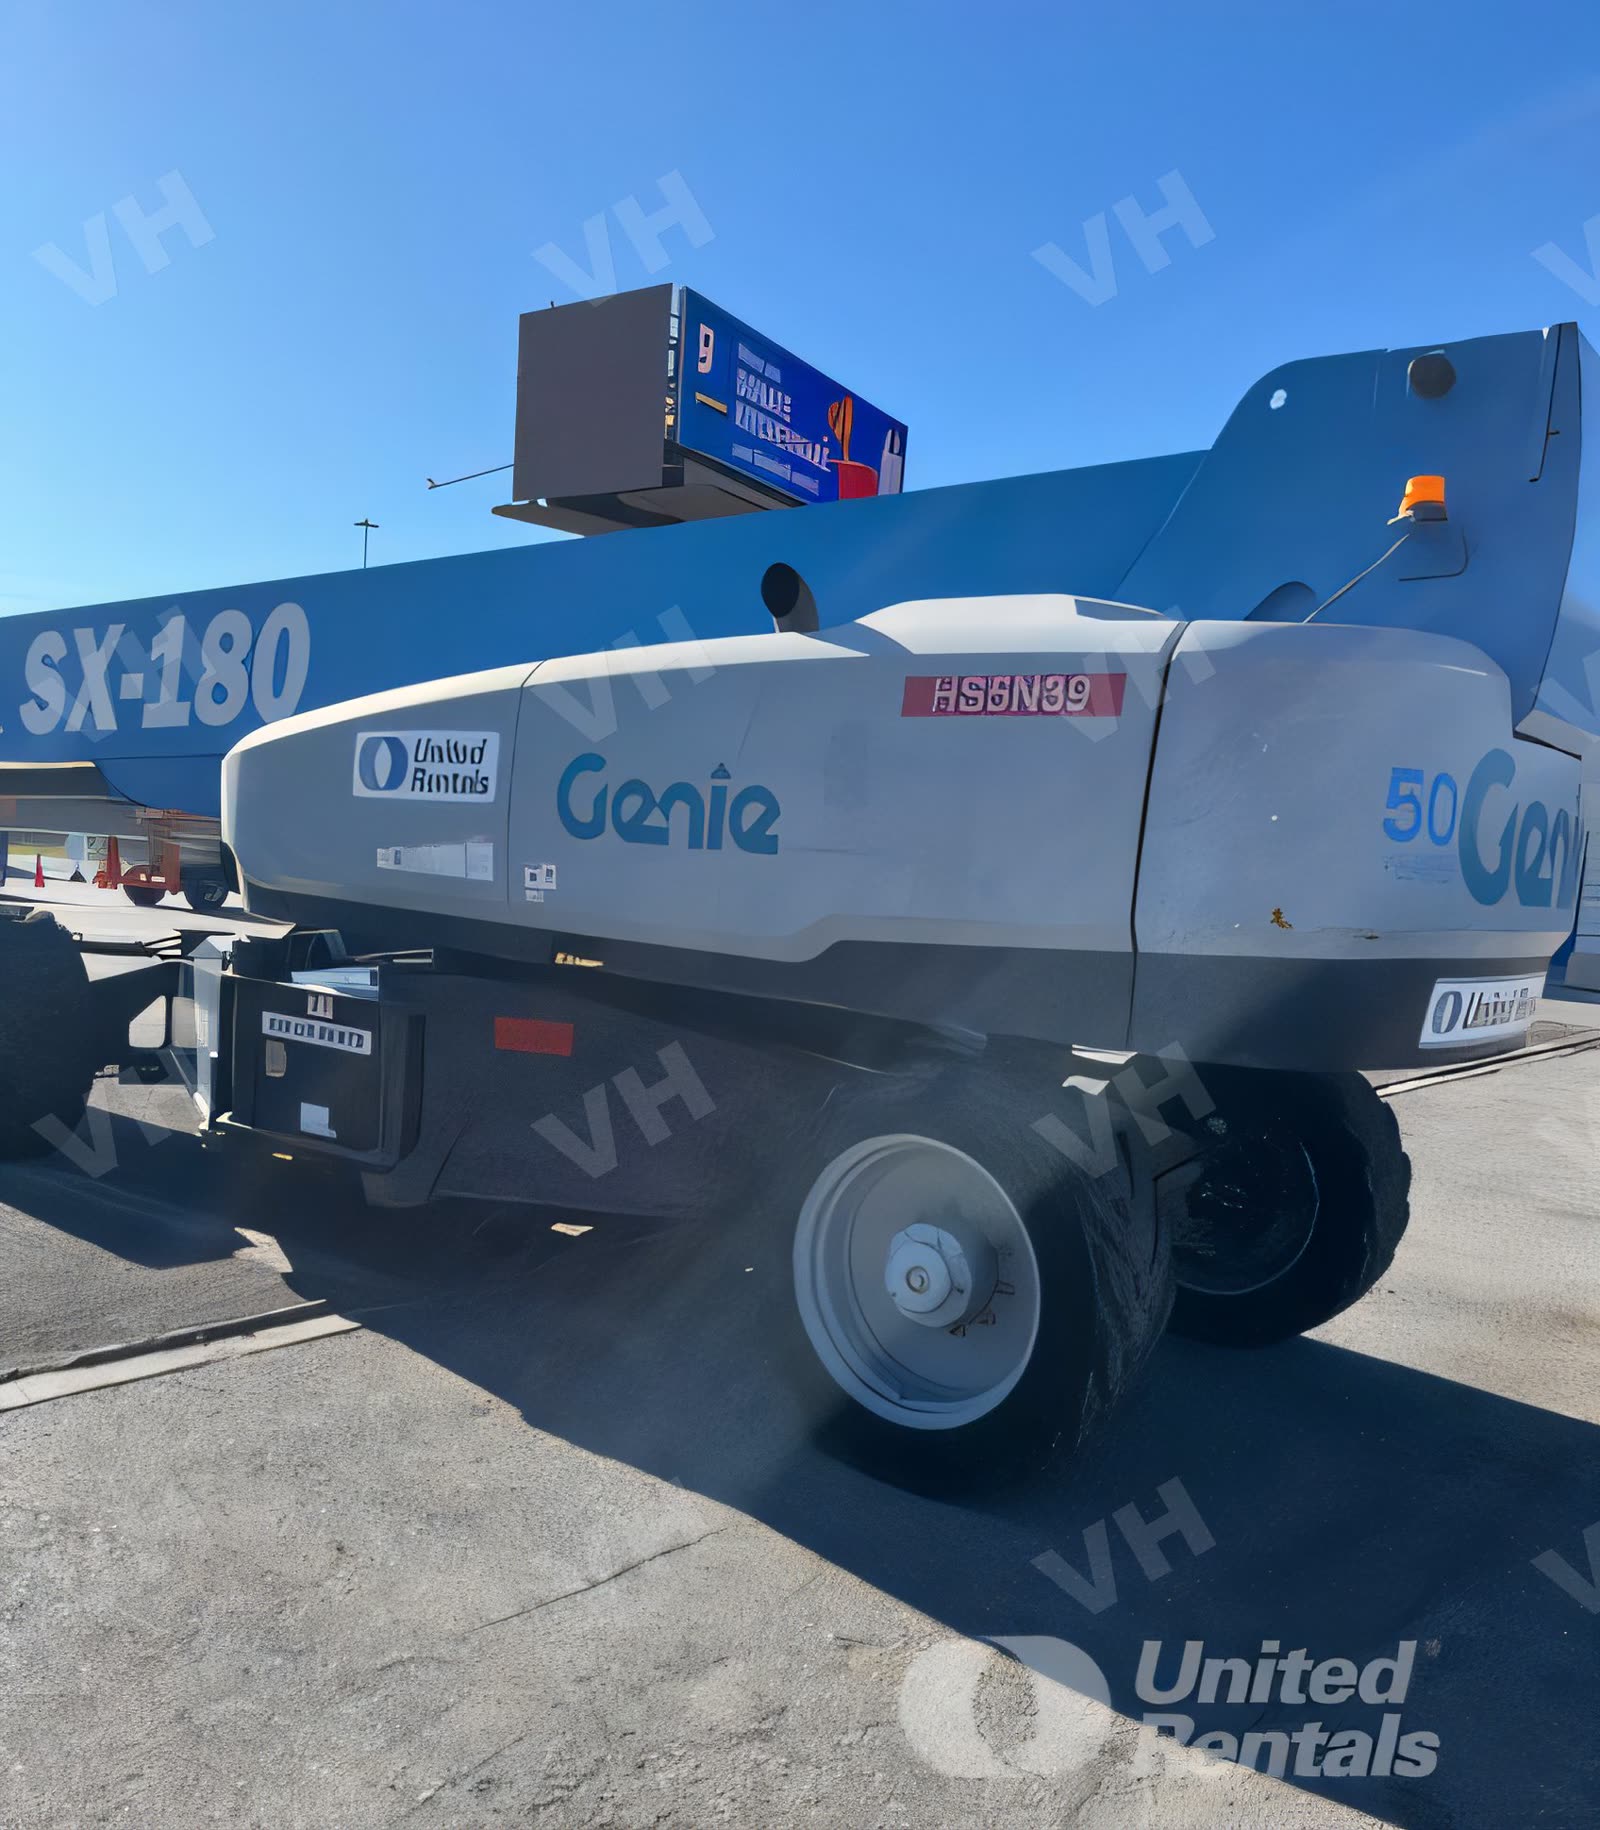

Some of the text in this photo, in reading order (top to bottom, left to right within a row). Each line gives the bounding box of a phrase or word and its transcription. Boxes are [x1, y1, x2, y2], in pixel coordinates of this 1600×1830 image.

[20, 602, 310, 735] SX-180
[557, 752, 781, 855] Genie
[1383, 767, 1457, 846] 50
